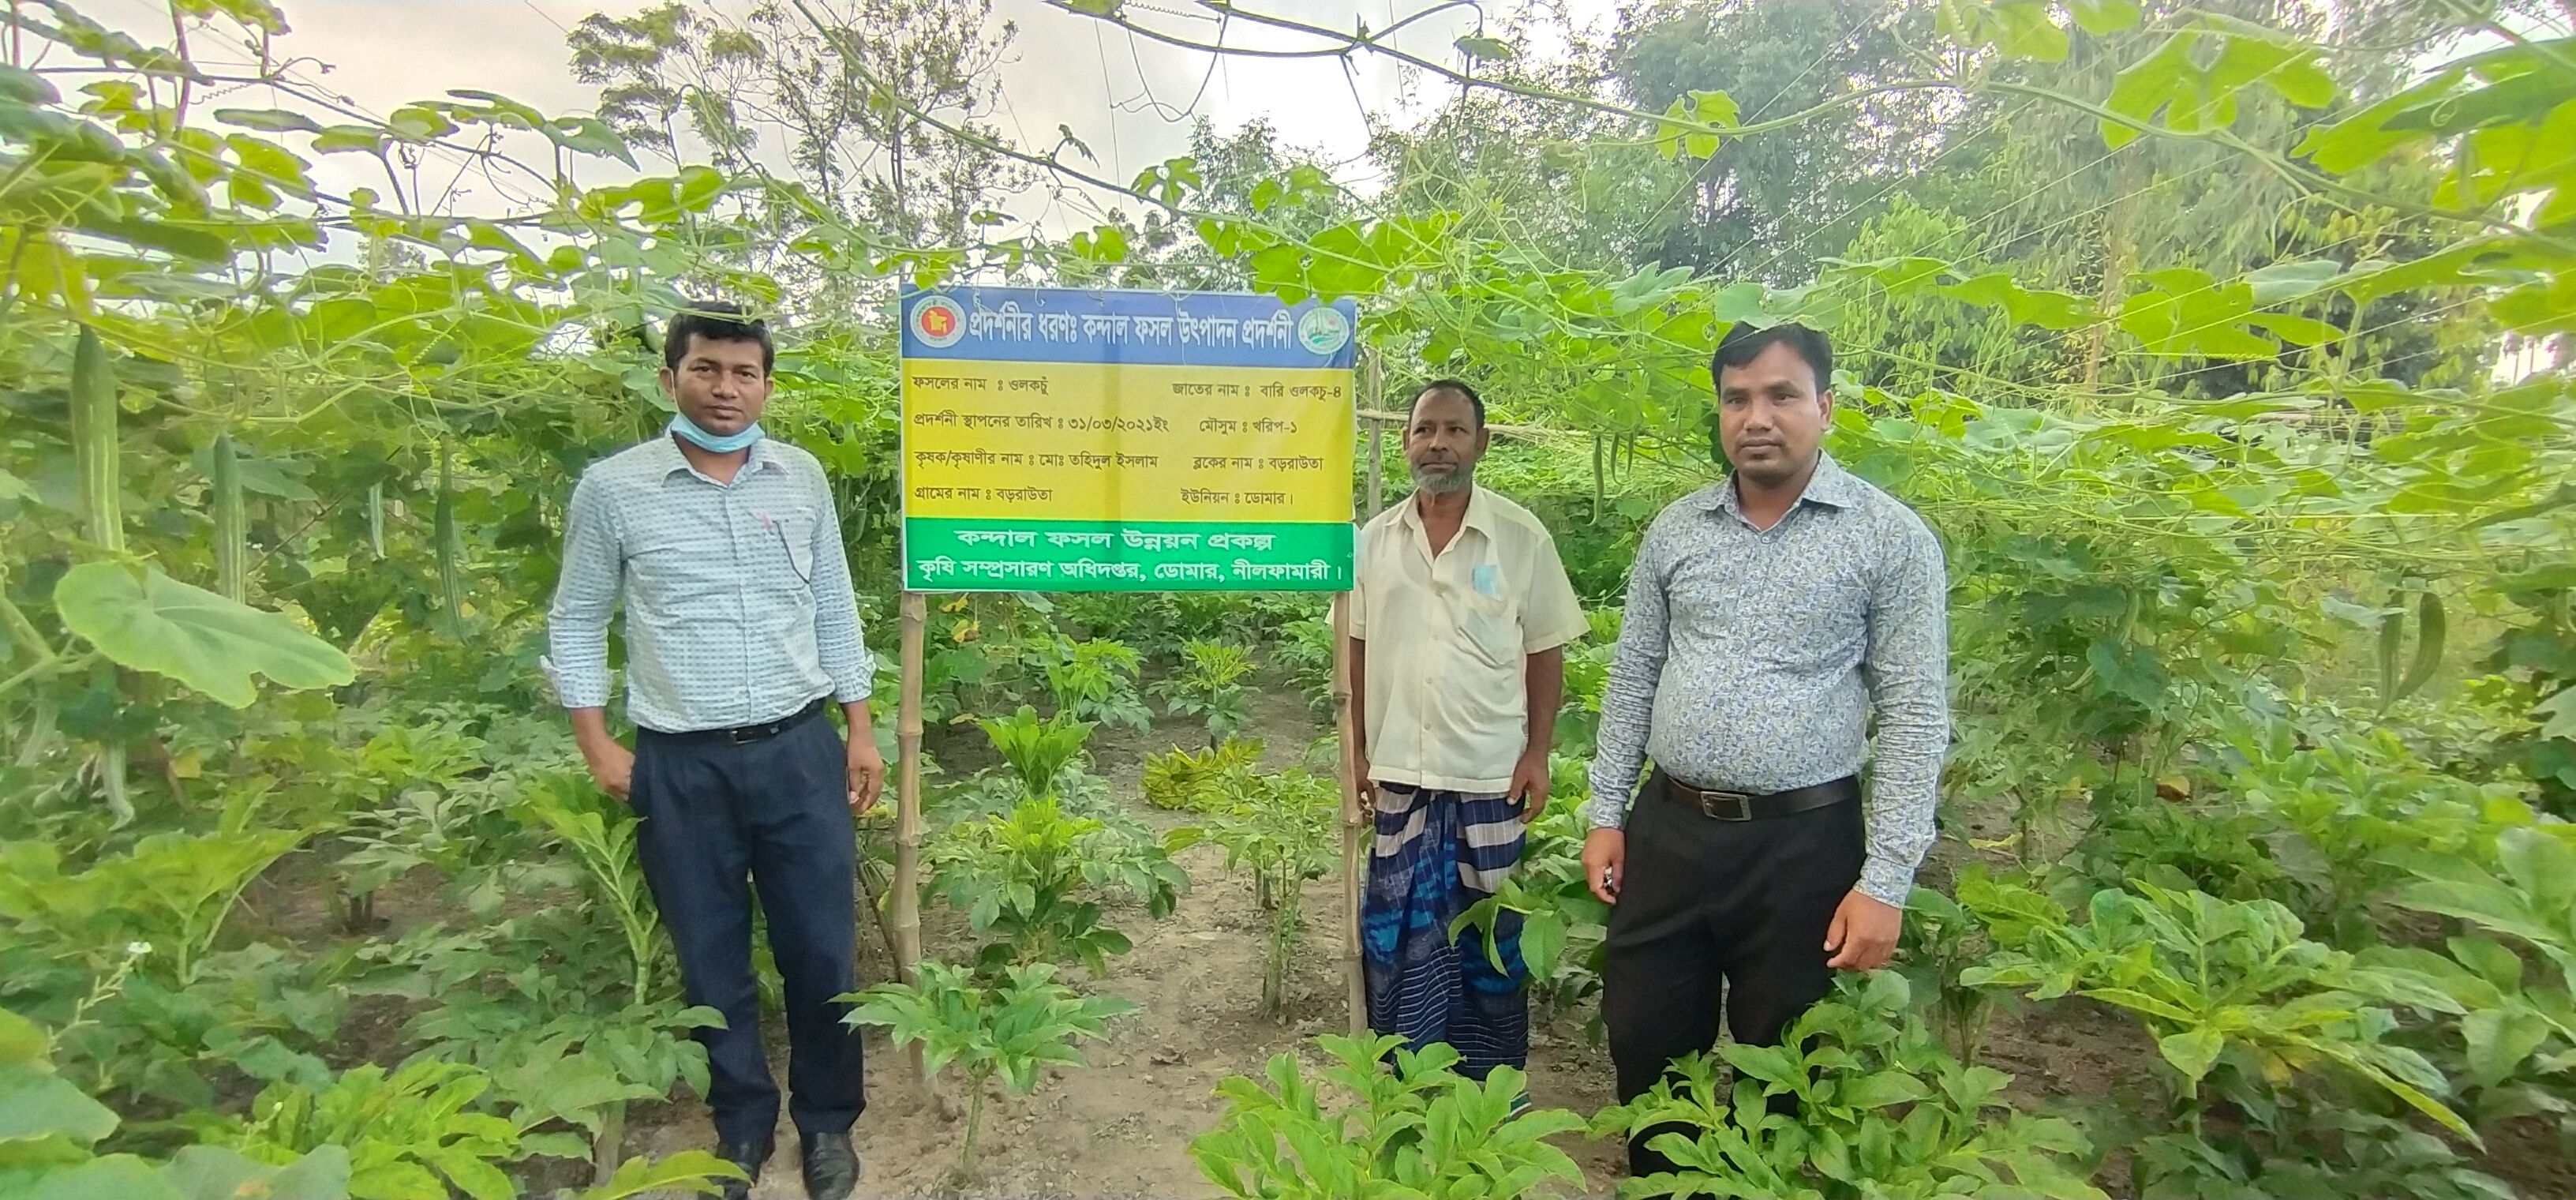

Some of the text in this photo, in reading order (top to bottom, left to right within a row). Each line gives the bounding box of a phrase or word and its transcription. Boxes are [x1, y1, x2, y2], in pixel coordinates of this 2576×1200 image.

[1133, 316, 1174, 346] ফসল
[963, 378, 987, 391] নাম
[1217, 384, 1240, 396] নাম
[1000, 452, 1024, 466] নাম
[1230, 456, 1253, 469] নাম
[957, 487, 981, 501] নাম
[1044, 531, 1114, 548] ফসল
